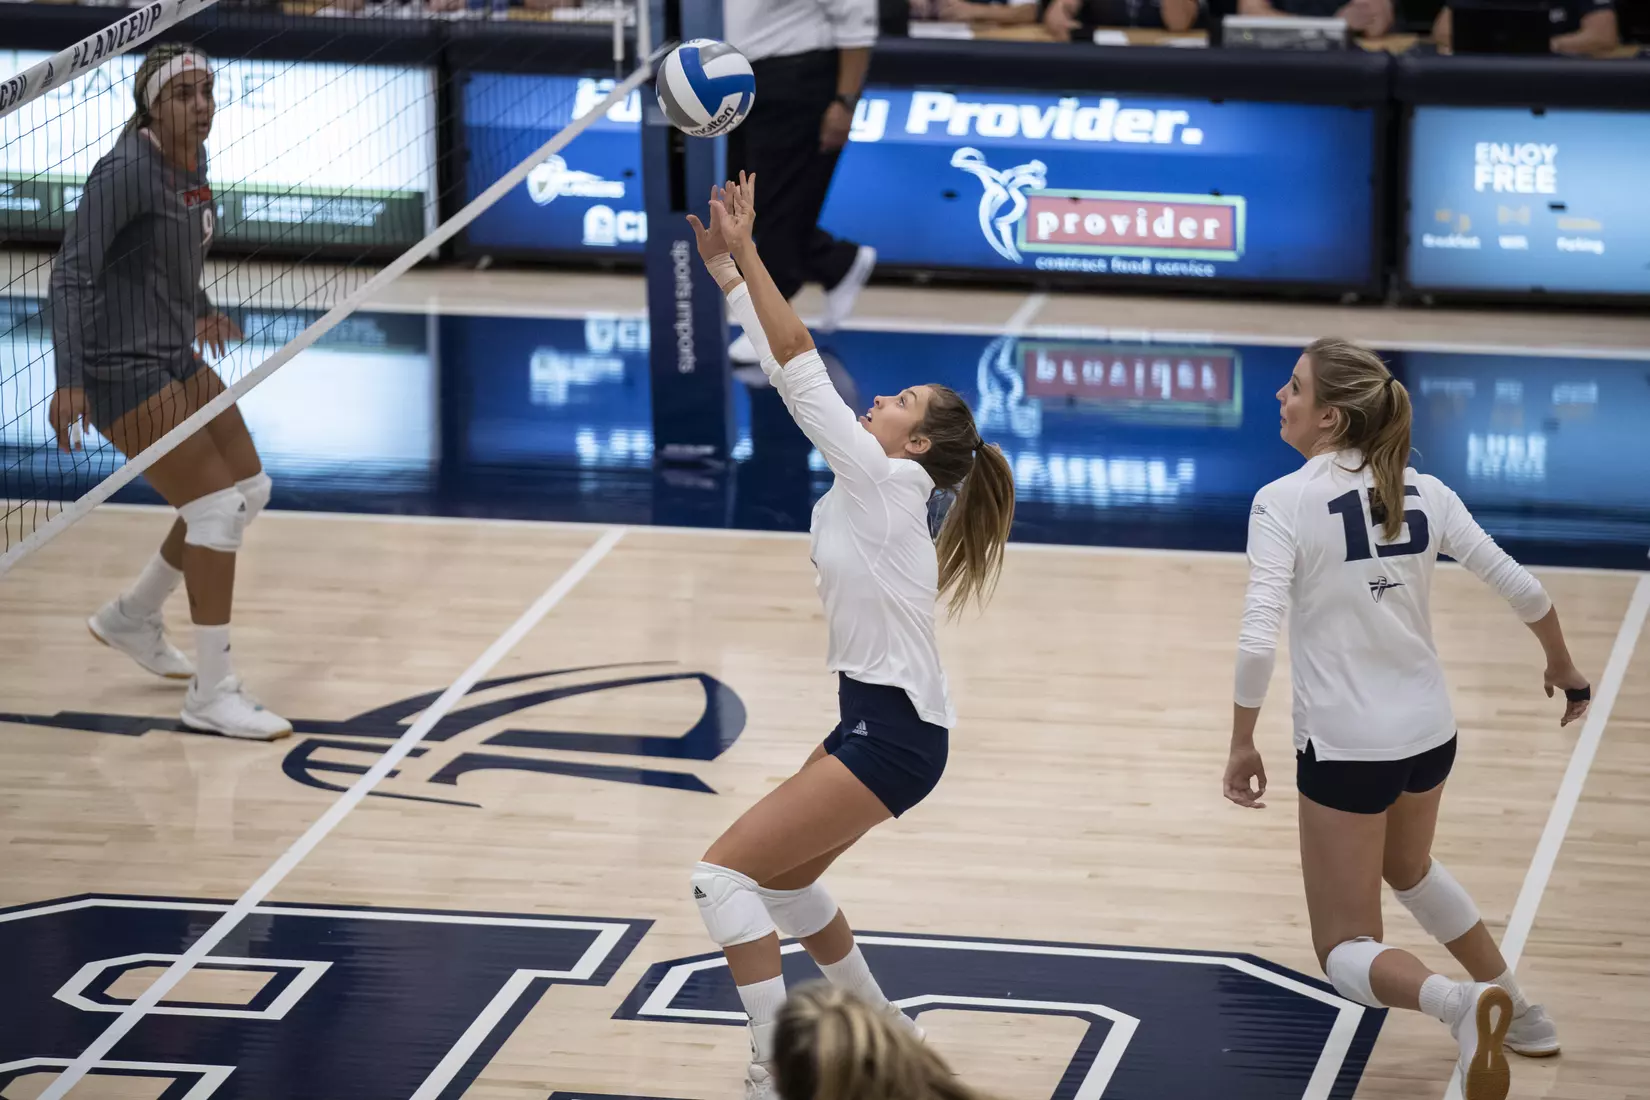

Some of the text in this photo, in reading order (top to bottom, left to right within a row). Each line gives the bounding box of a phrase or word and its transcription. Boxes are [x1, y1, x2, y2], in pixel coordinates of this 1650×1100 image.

[69, 3, 162, 74] #LANCEUP
[690, 106, 734, 136] molten
[905, 91, 1204, 145] Provider.
[1474, 142, 1558, 166] ENJOY
[1474, 164, 1557, 194] FREE
[1036, 206, 1221, 241] provider
[1110, 256, 1152, 275] food
[1154, 260, 1217, 278] service
[669, 240, 698, 374] sports imports
[1327, 485, 1430, 562] 15
